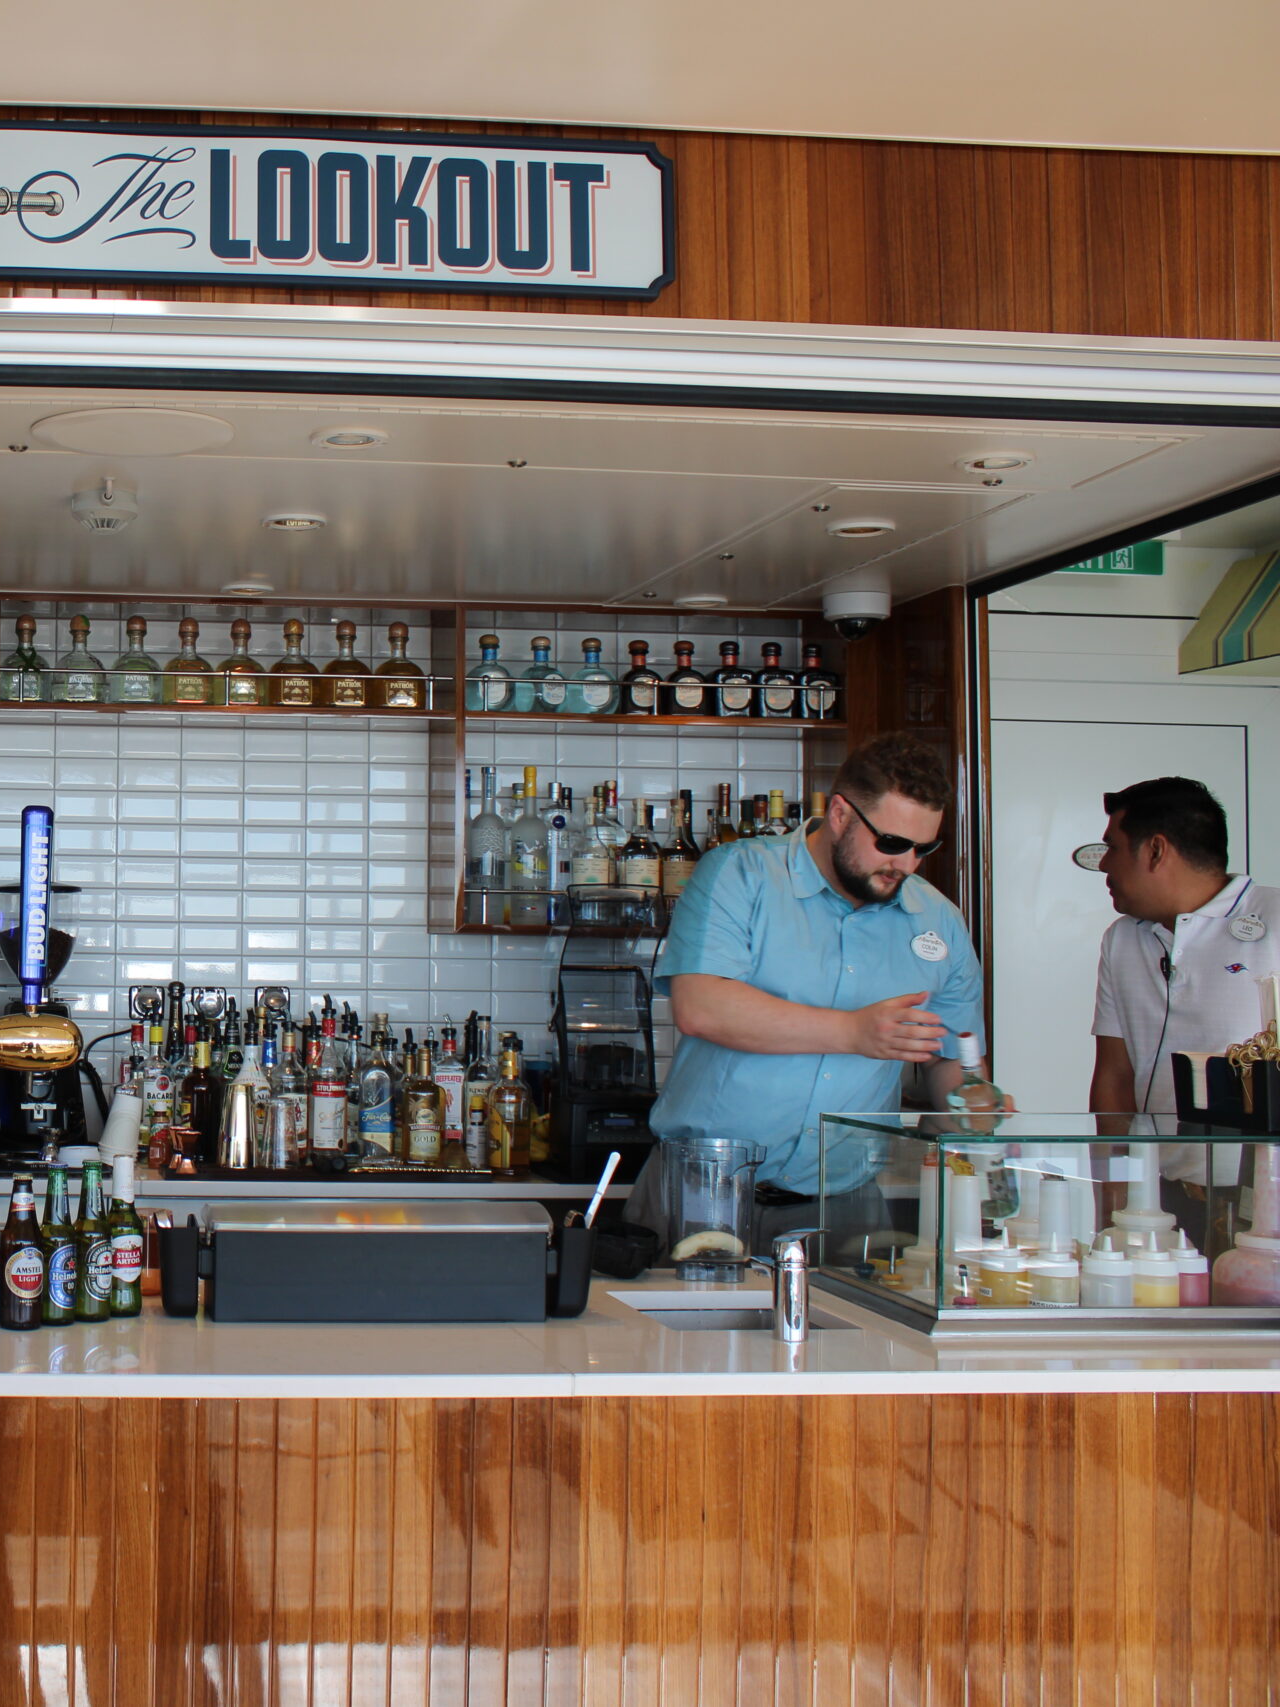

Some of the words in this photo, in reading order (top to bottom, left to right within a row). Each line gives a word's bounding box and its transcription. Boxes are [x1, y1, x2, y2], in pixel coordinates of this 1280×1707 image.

[60, 146, 196, 245] The
[210, 149, 609, 278] LOOKOUT
[29, 833, 48, 905] LIGHT
[27, 910, 46, 961] BUD
[88, 1265, 112, 1274] Heine
[116, 1251, 140, 1259] STELLA
[52, 1271, 76, 1281] Heinek
